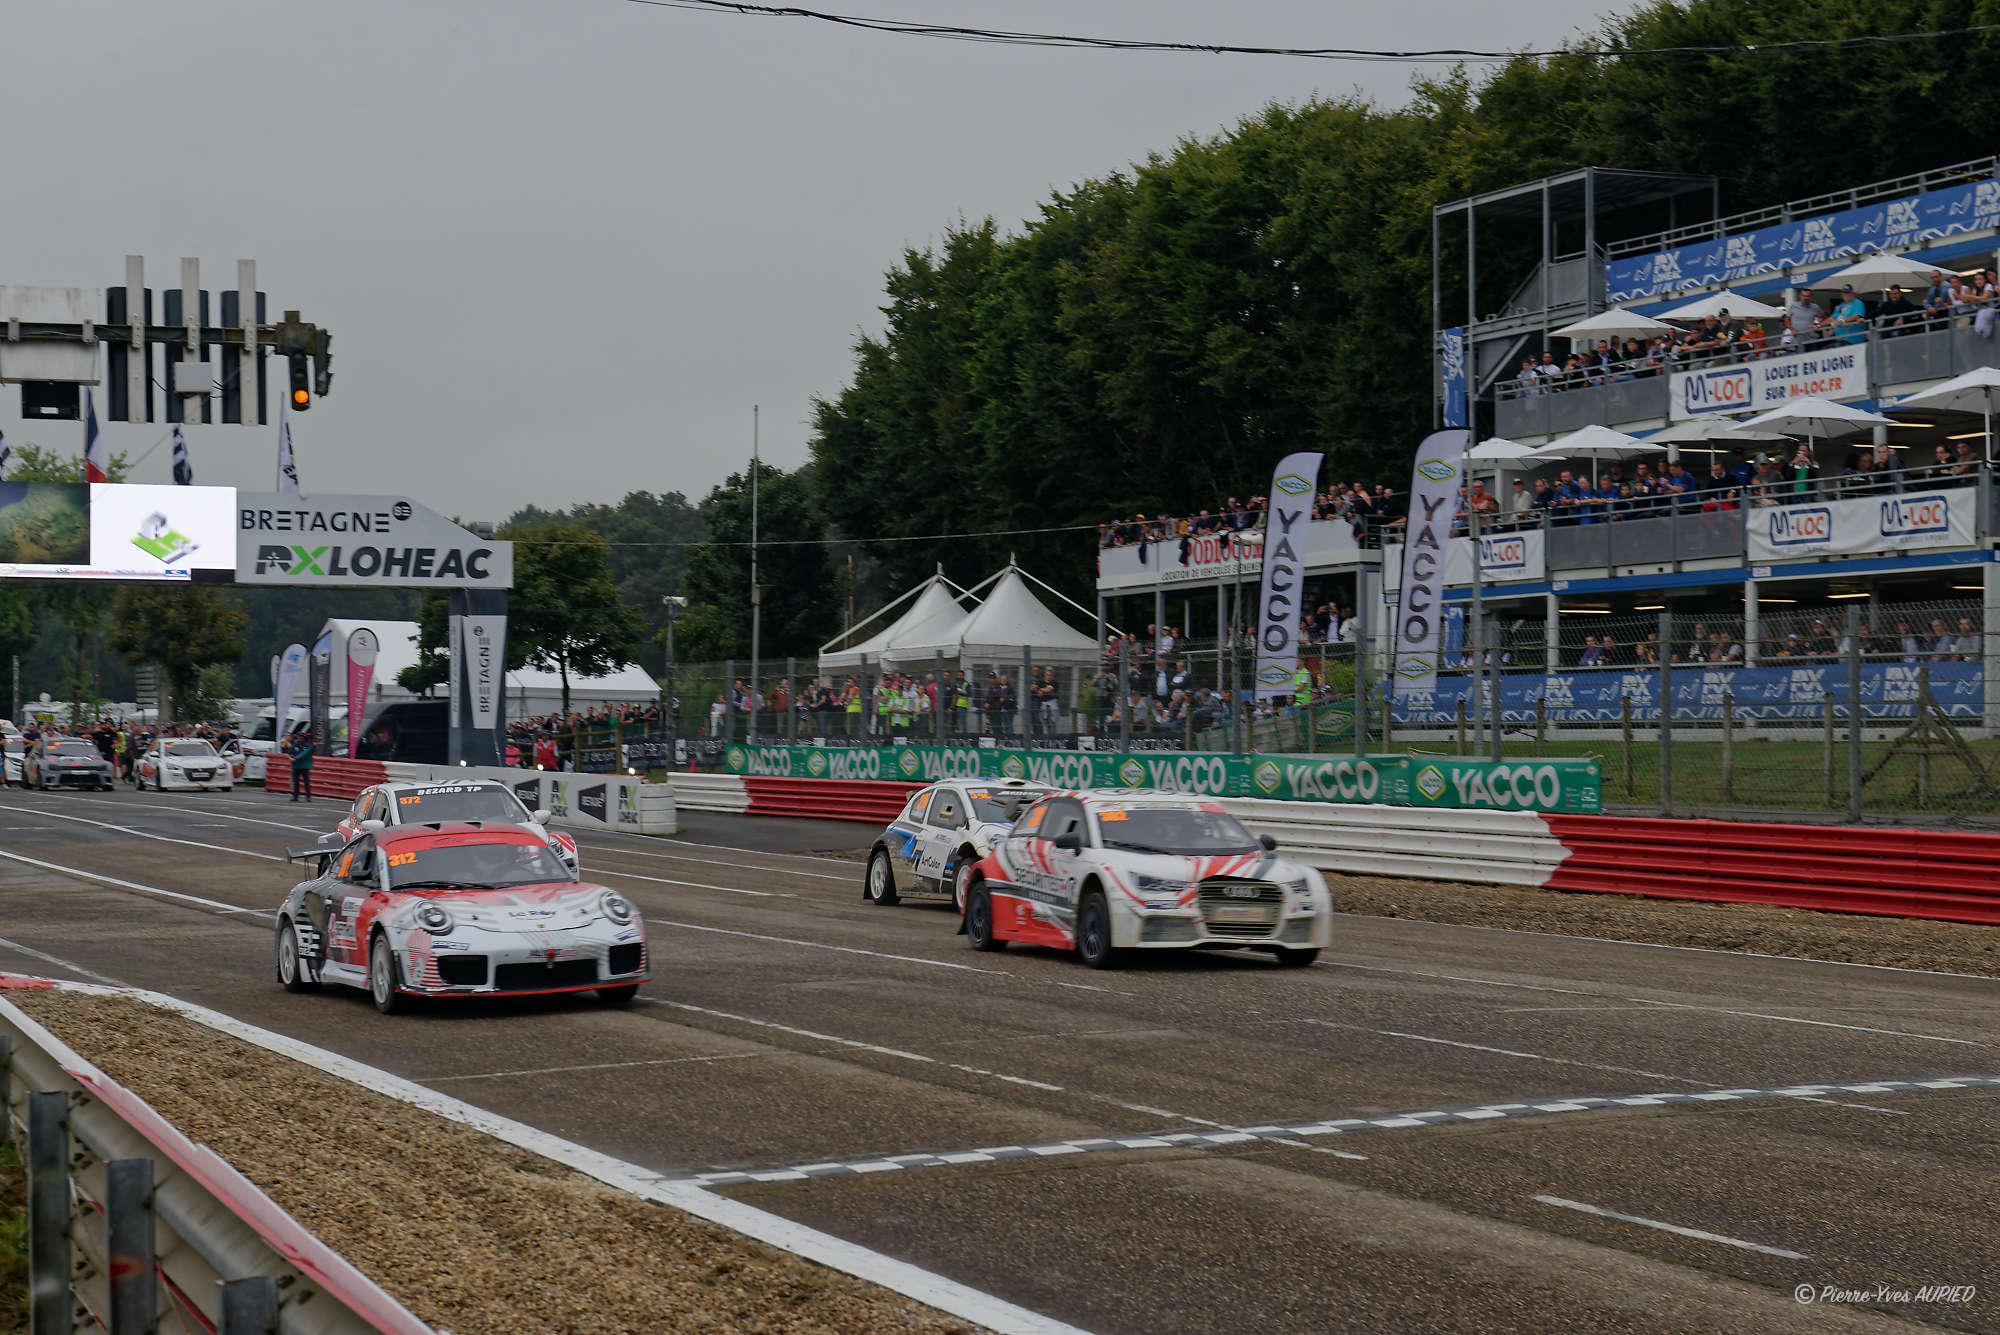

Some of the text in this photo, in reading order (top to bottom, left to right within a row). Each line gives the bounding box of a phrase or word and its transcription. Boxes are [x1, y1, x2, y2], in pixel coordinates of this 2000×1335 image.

[1765, 355, 1854, 381] LOUEZ EN LIGNE
[1685, 375, 1744, 403] M-LOC
[1765, 377, 1842, 400] SUR M-LOC.FR
[240, 509, 390, 533] BRETAGNE
[1770, 511, 1824, 536] M-LOC
[1881, 500, 1942, 527] M-LOC
[1263, 508, 1303, 652] YACCO
[1404, 494, 1448, 643] YACCO
[480, 637, 490, 713] BRETAGNE
[746, 749, 791, 776] YACCO
[829, 749, 880, 779] YACCO
[922, 749, 980, 779] YACCO
[1027, 755, 1093, 790] YACCO
[1149, 757, 1226, 794] YACCO
[417, 786, 462, 796] BEZARD
[1287, 761, 1379, 799] YACCO
[1452, 765, 1560, 808] YACCO
[400, 796, 423, 805] 372
[388, 852, 418, 867] 312
